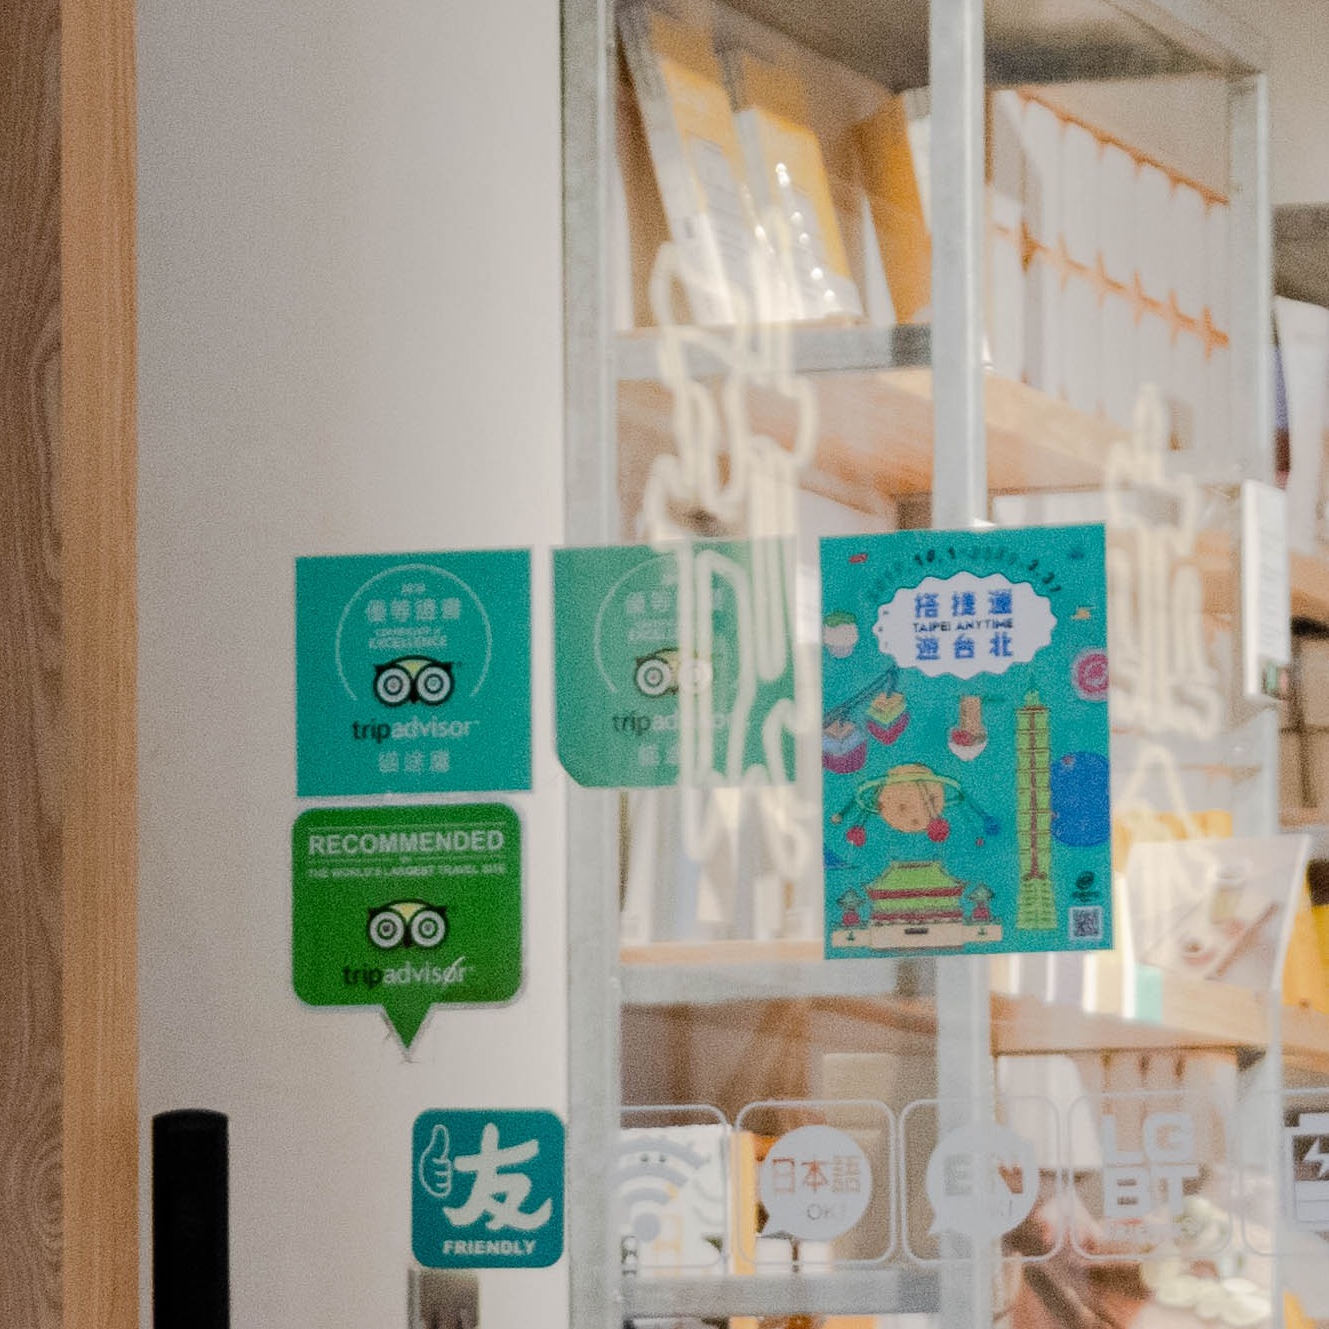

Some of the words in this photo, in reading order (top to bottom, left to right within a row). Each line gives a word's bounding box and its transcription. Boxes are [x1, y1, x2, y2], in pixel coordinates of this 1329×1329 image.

[912, 621, 952, 633] TAIPEI
[956, 618, 1014, 632] ANYTIME
[351, 716, 472, 744] tripadvisor
[308, 829, 505, 855] RECOMMENDED
[343, 957, 466, 990] tripadvisor
[442, 1121, 553, 1231] 友
[442, 1239, 537, 1256] FRIENDLY
